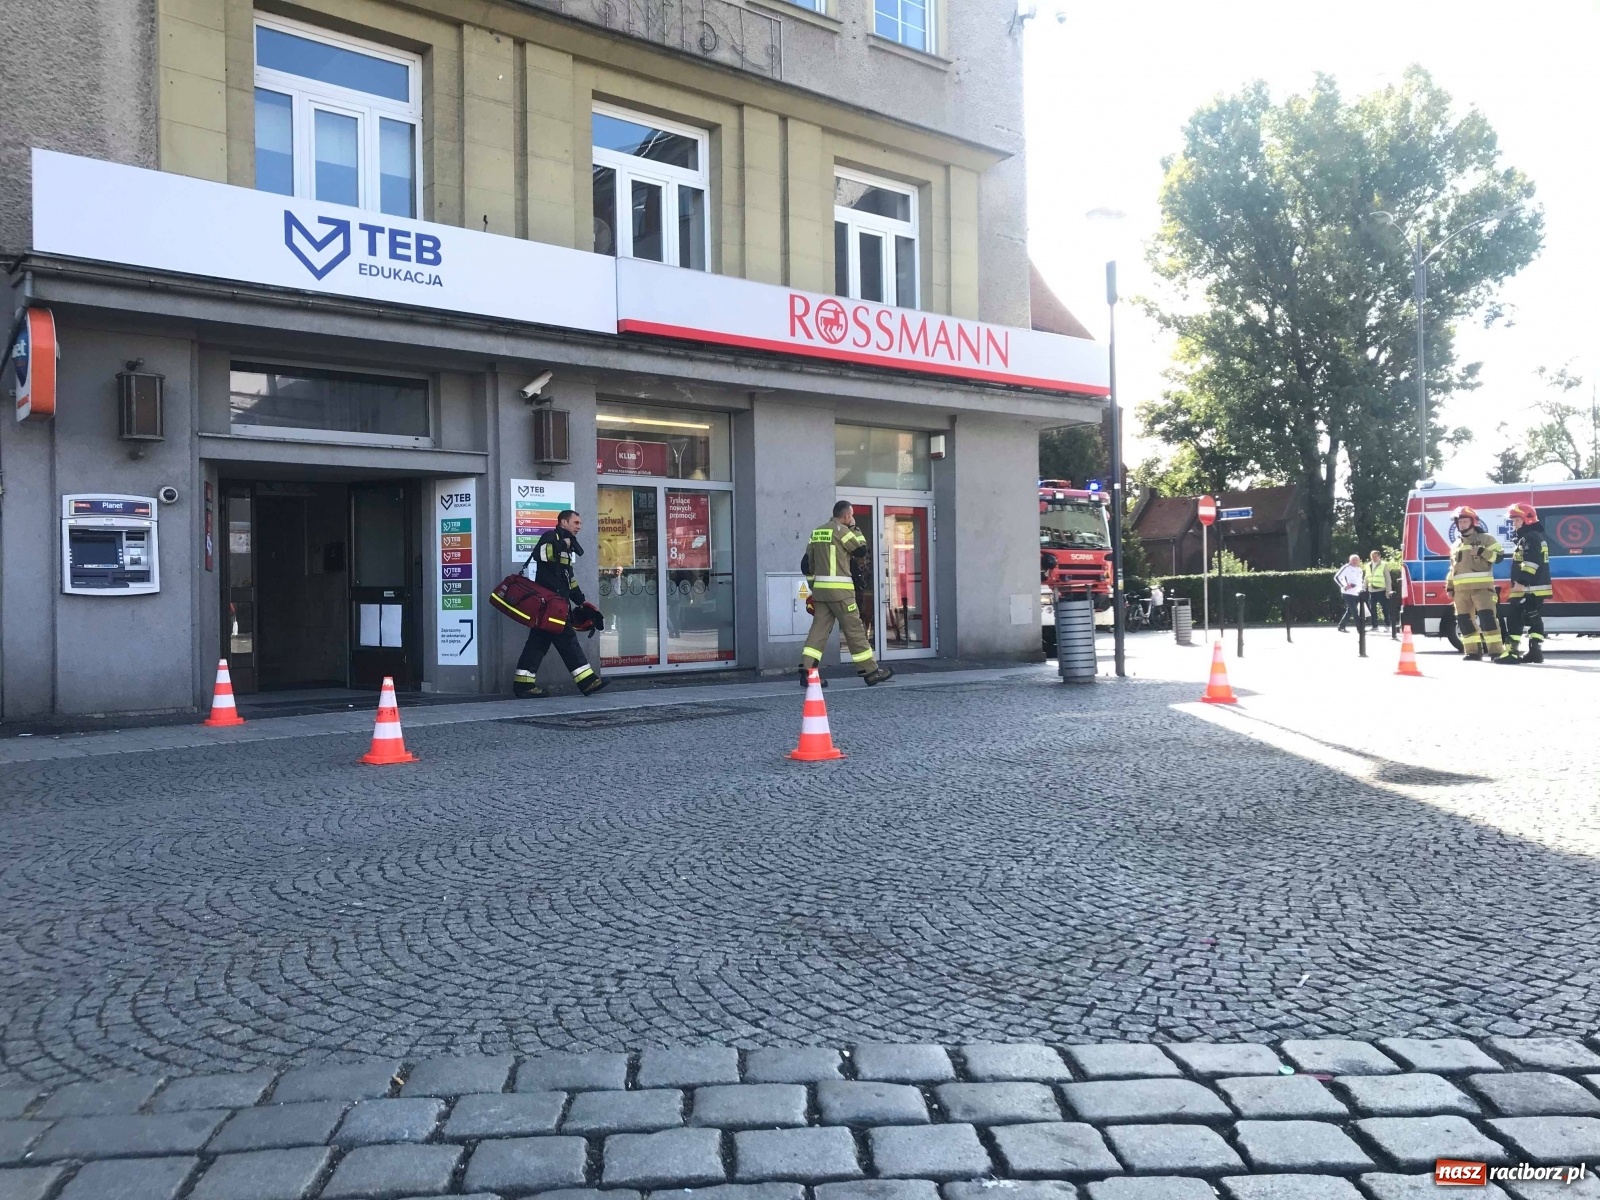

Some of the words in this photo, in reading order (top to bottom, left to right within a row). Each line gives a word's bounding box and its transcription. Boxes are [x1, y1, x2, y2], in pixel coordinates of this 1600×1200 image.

[359, 222, 442, 266] TEB
[358, 262, 444, 288] EDUKACJA
[788, 293, 1010, 369] ROSSMANN
[454, 494, 471, 502] TEB
[1568, 523, 1582, 540] S
